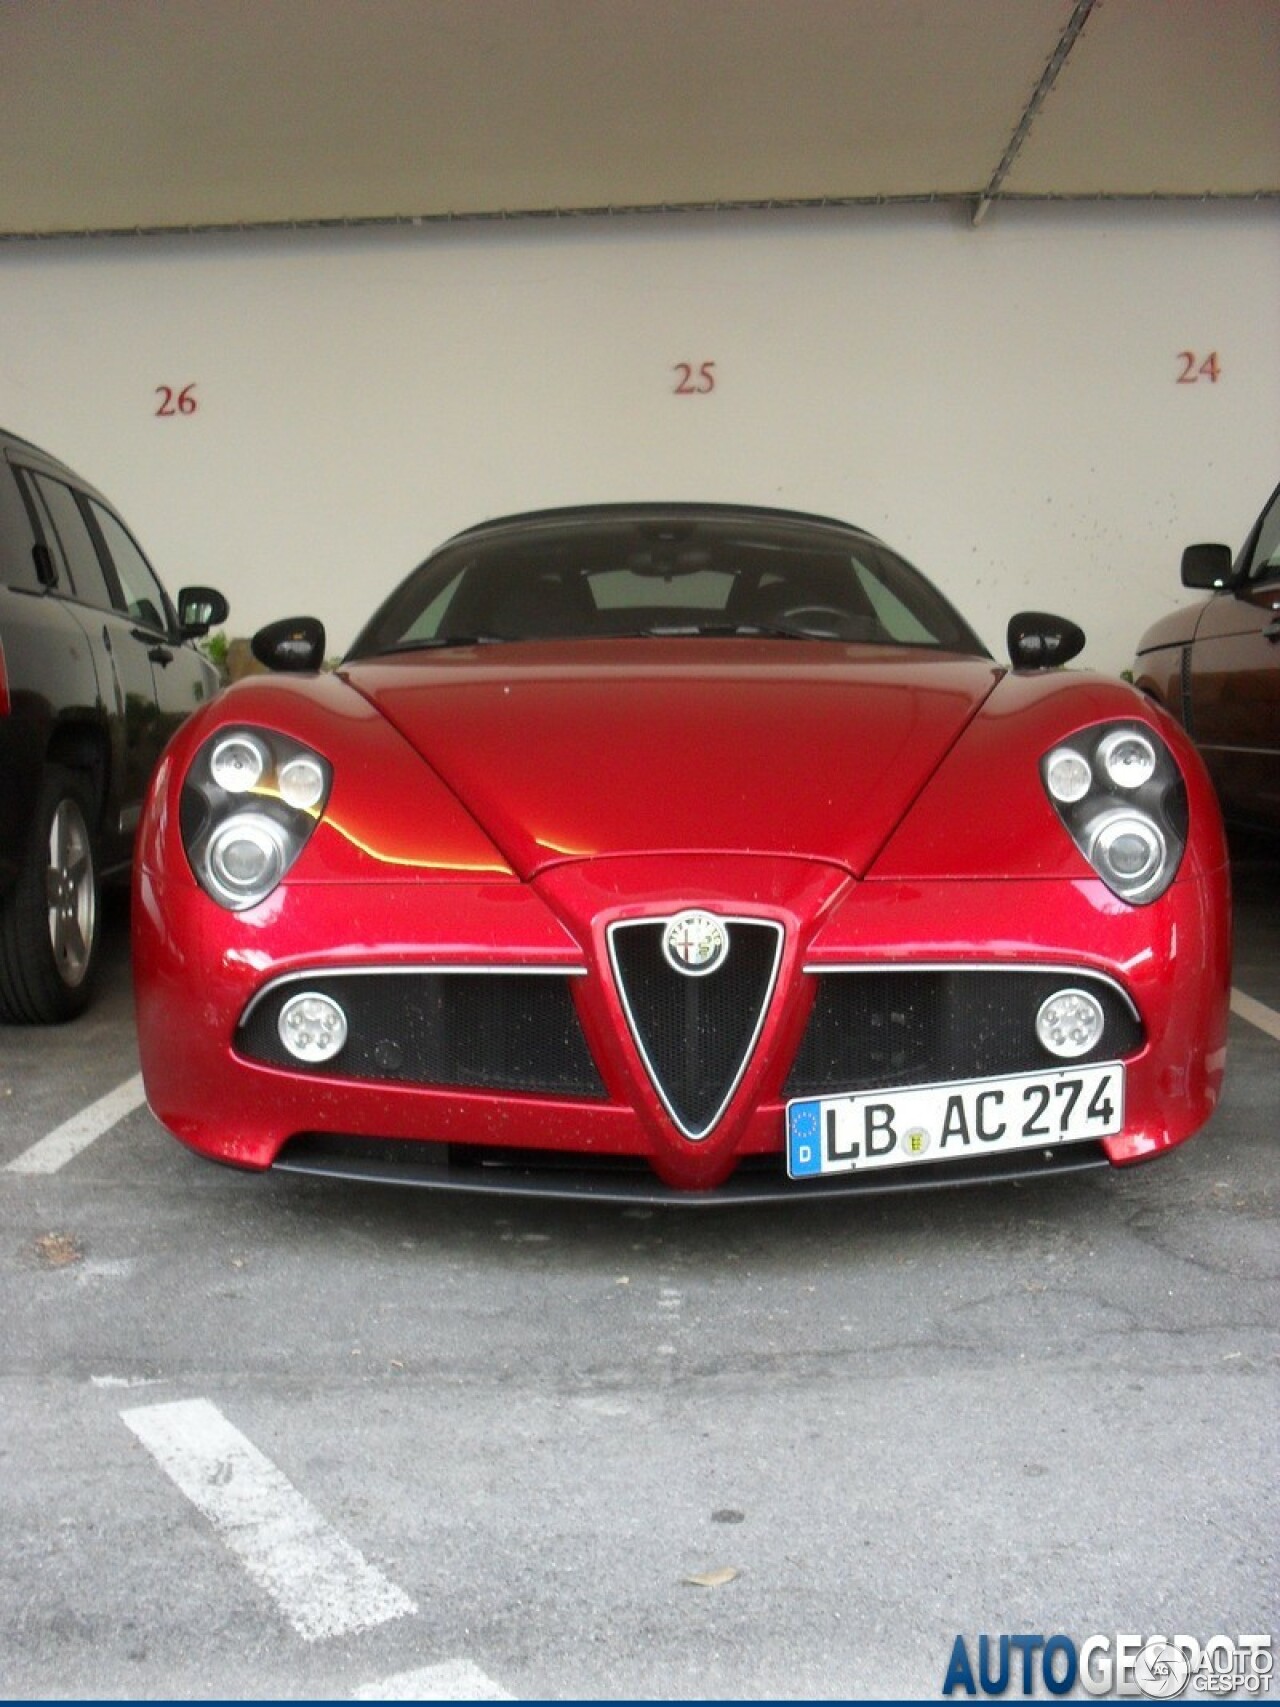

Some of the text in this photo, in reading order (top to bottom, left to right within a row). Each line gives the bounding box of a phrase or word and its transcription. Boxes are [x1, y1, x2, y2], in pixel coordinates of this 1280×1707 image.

[673, 361, 716, 395] 25
[1176, 350, 1222, 384] 24
[155, 382, 197, 417] 26
[826, 1075, 1115, 1162] LB AC 274
[799, 1146, 811, 1163] D
